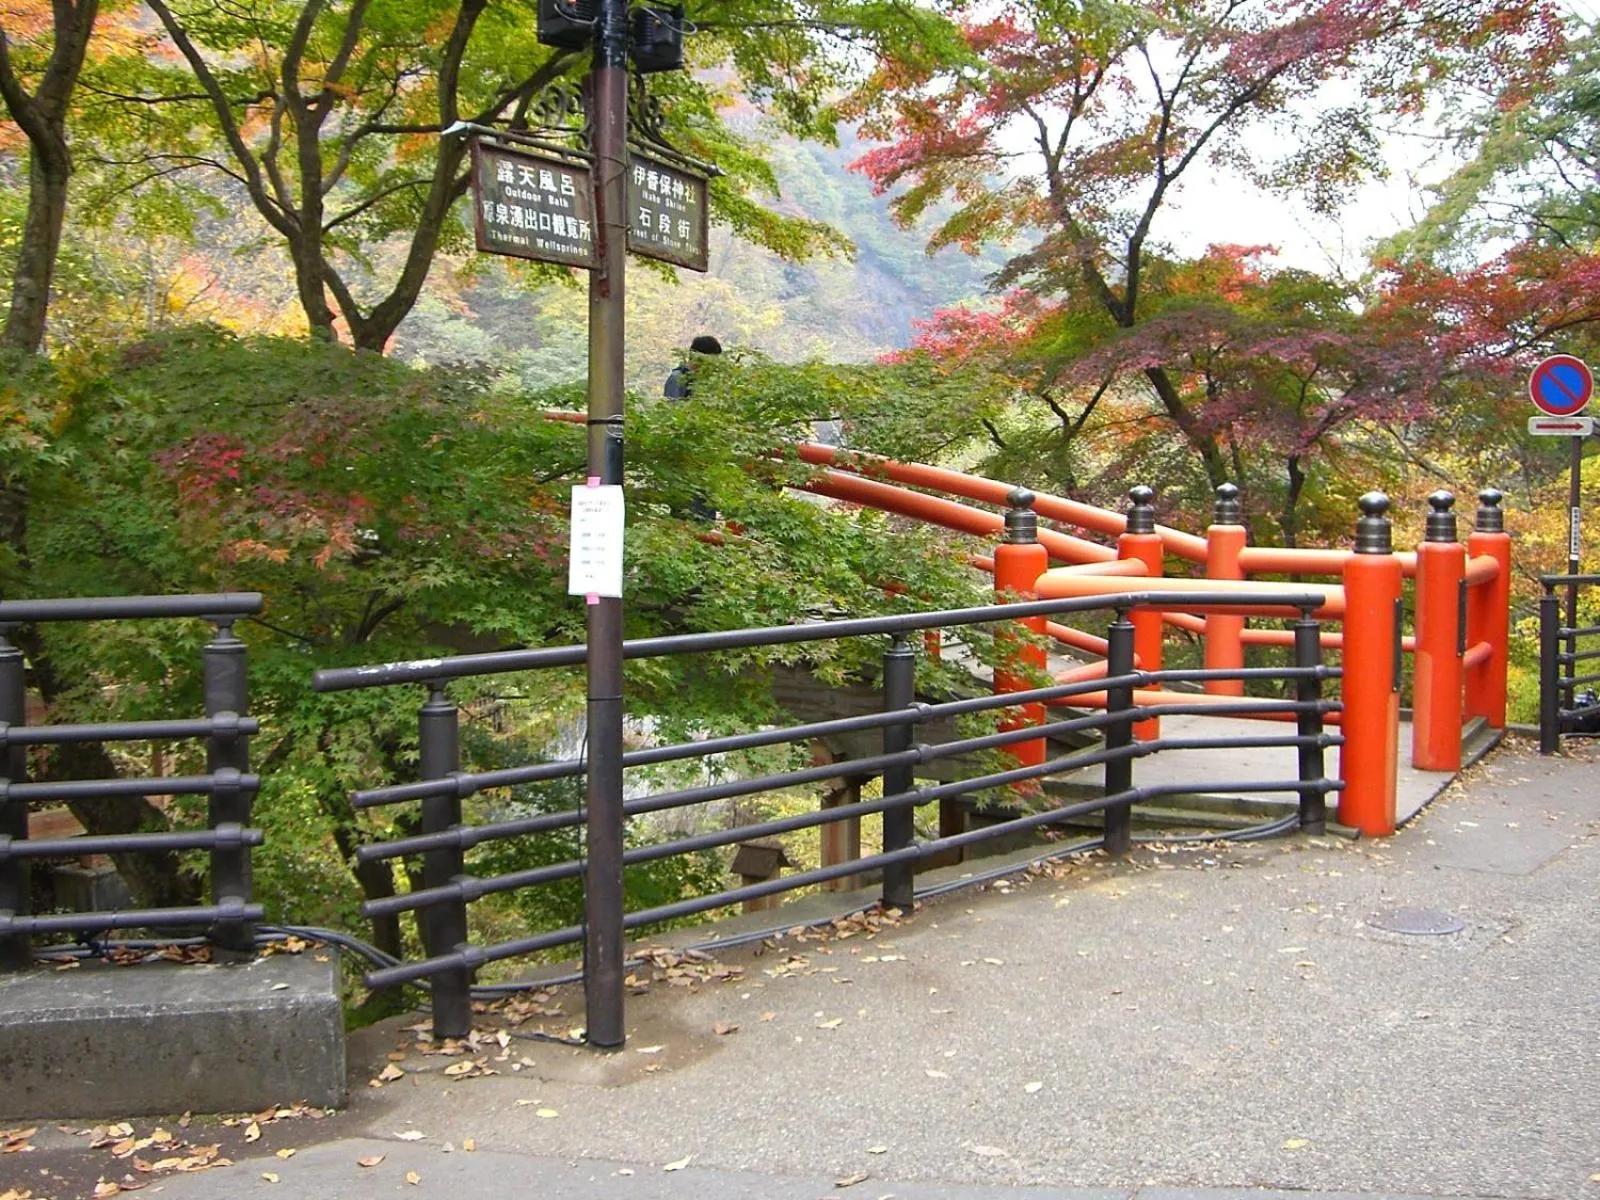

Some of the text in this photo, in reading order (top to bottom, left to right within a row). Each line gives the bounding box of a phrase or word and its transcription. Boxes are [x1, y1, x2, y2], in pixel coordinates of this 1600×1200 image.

[496, 160, 576, 196] 露天風呂
[633, 164, 697, 204] 伊香保神社
[505, 186, 569, 208] Outdoor Bath
[638, 206, 691, 240] 石段街
[491, 230, 589, 256] Thermal Wellsprings
